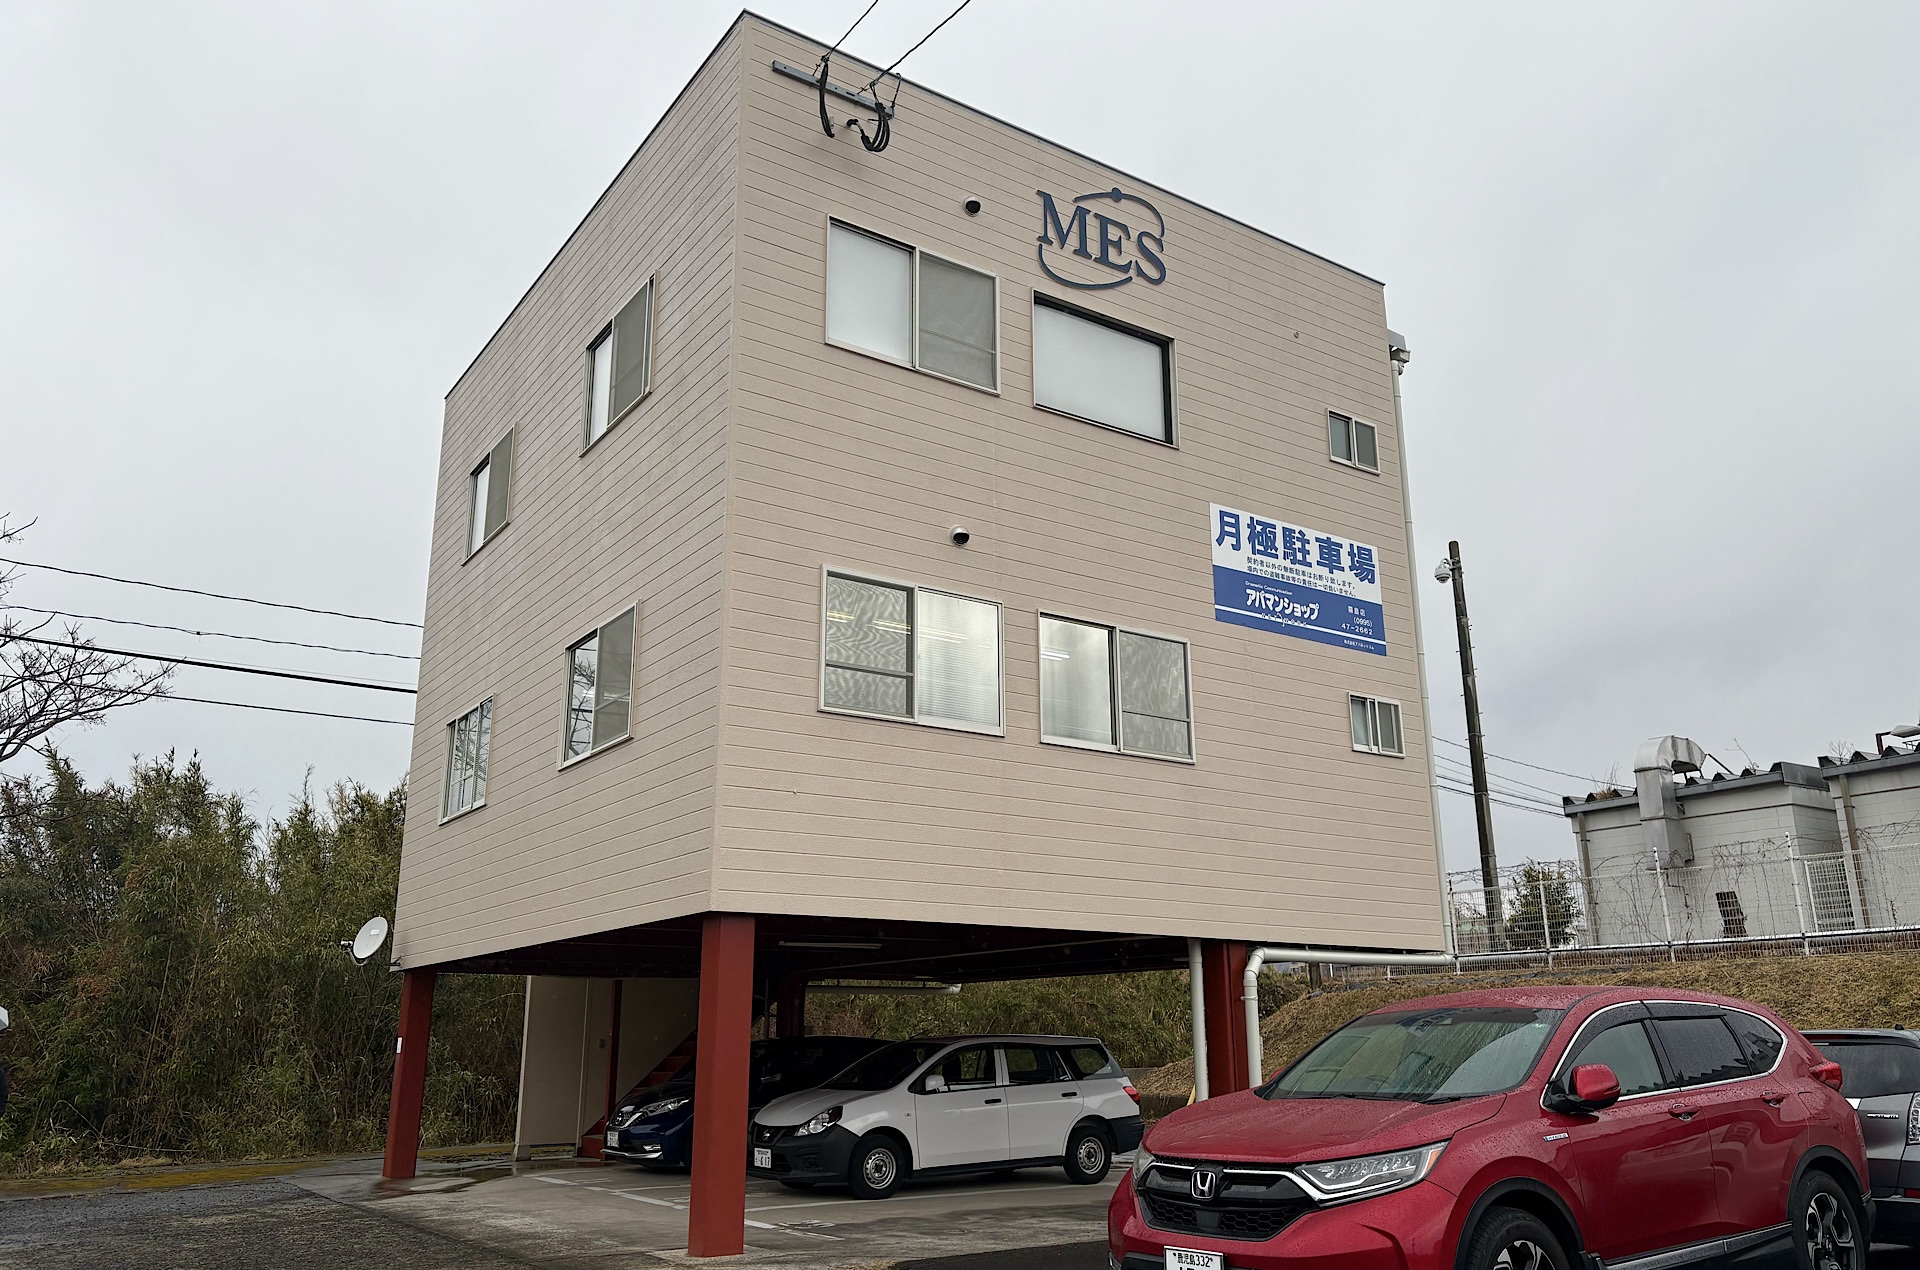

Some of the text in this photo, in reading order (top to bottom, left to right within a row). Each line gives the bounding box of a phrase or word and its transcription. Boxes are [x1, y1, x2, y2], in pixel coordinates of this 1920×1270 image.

[1036, 189, 1167, 285] MES
[1215, 509, 1376, 585] 月極駐車場
[1245, 588, 1320, 620] アパマンショップ
[1353, 617, 1373, 628] (0995)
